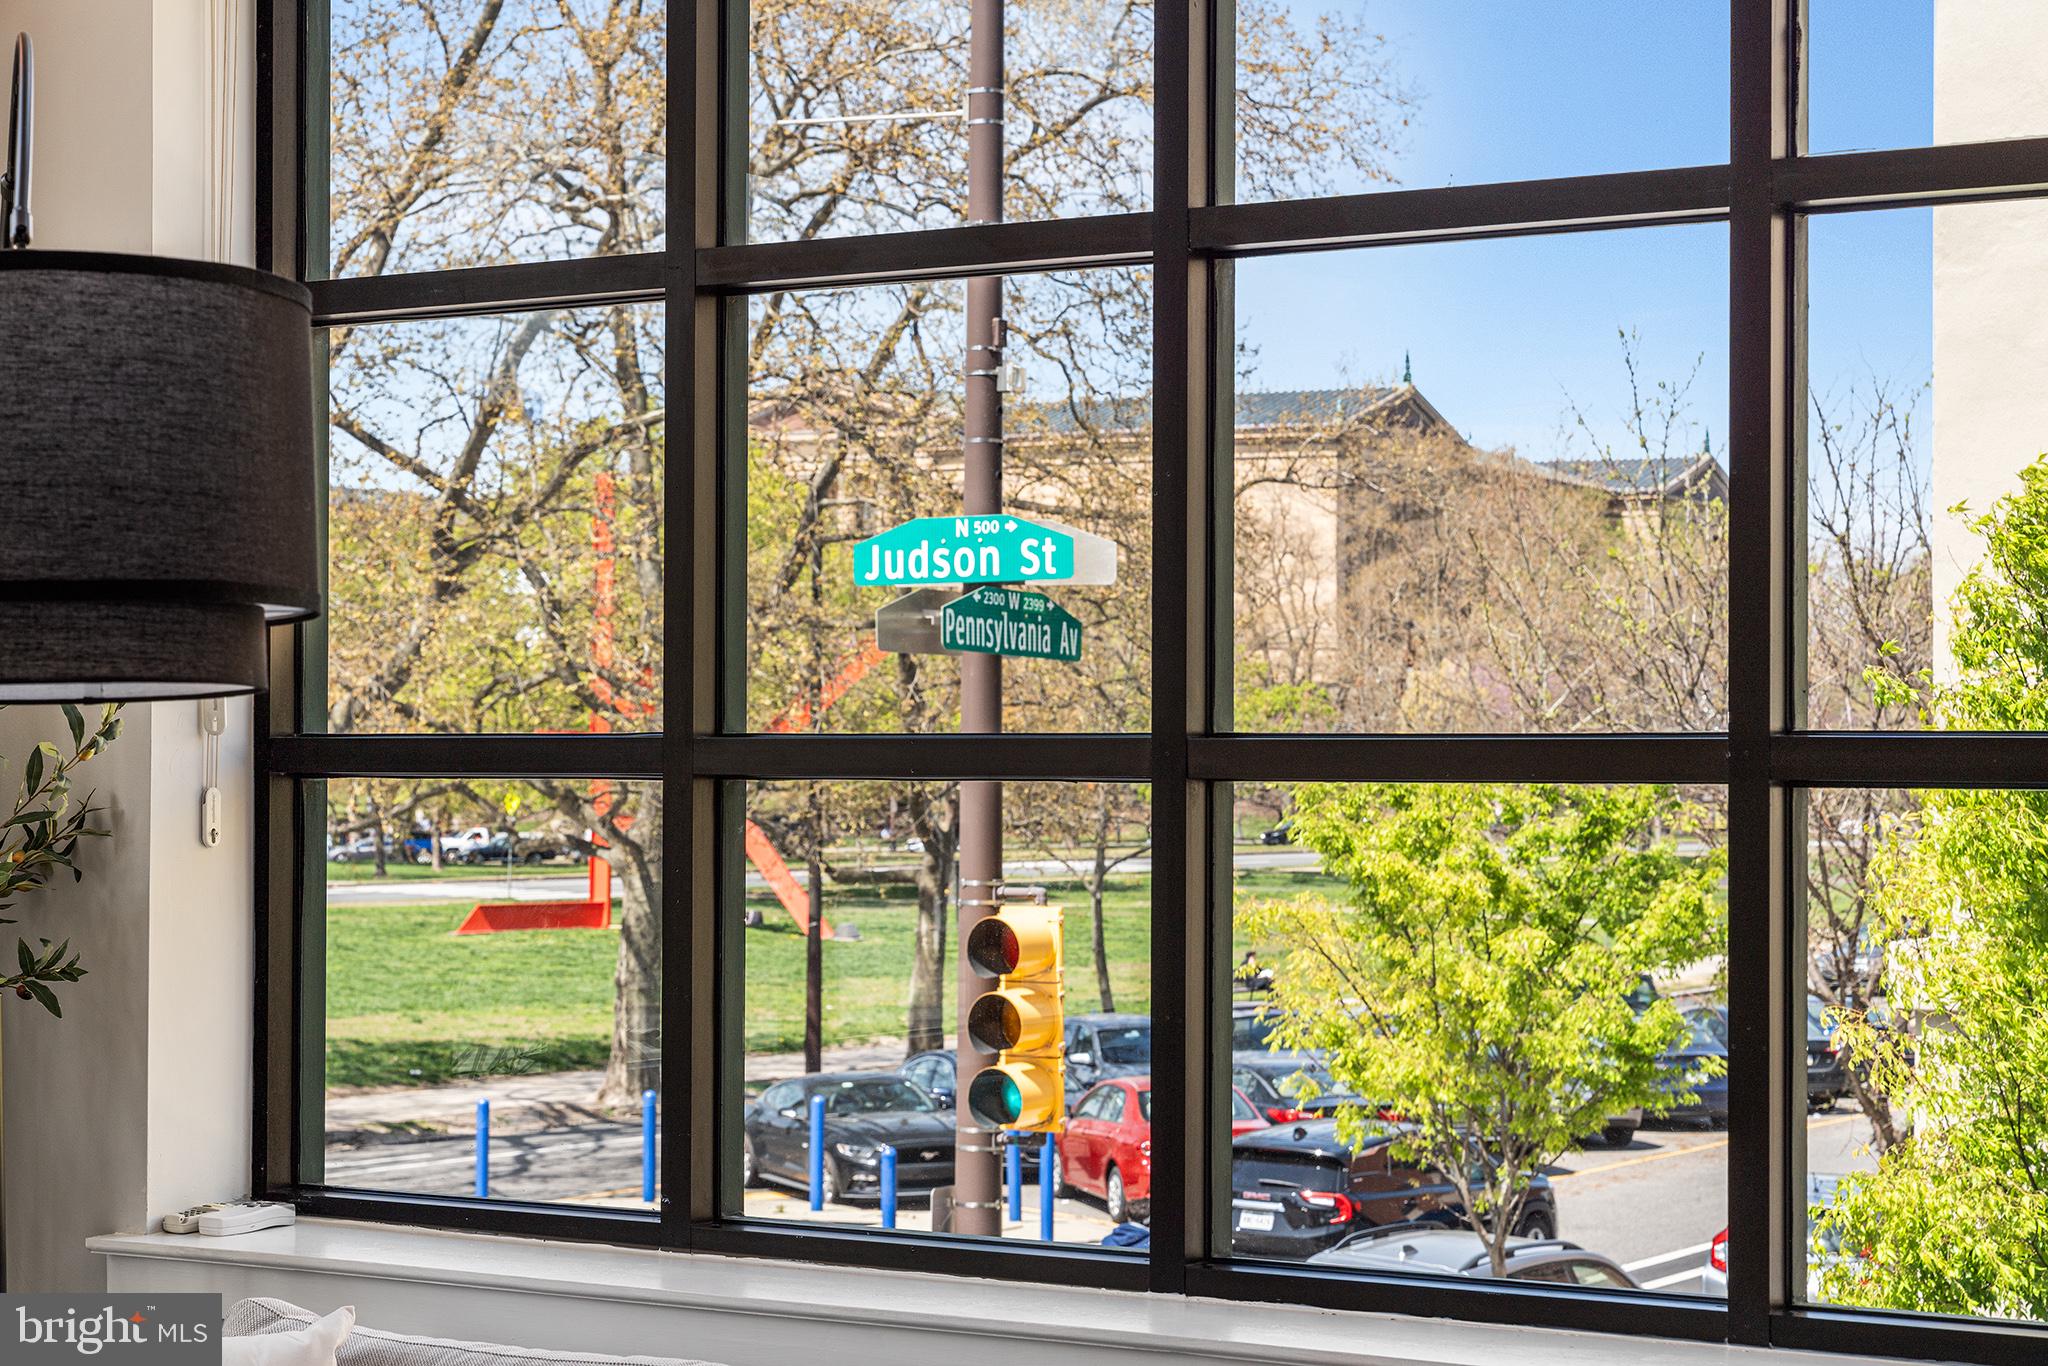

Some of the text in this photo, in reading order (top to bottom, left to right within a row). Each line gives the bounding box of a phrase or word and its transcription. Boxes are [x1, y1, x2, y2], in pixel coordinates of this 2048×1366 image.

[955, 518, 1000, 538] N 500
[864, 536, 1057, 581] Judson St
[983, 591, 1045, 612] 2300 W 2399
[945, 607, 1078, 656] Pennsylvania Av
